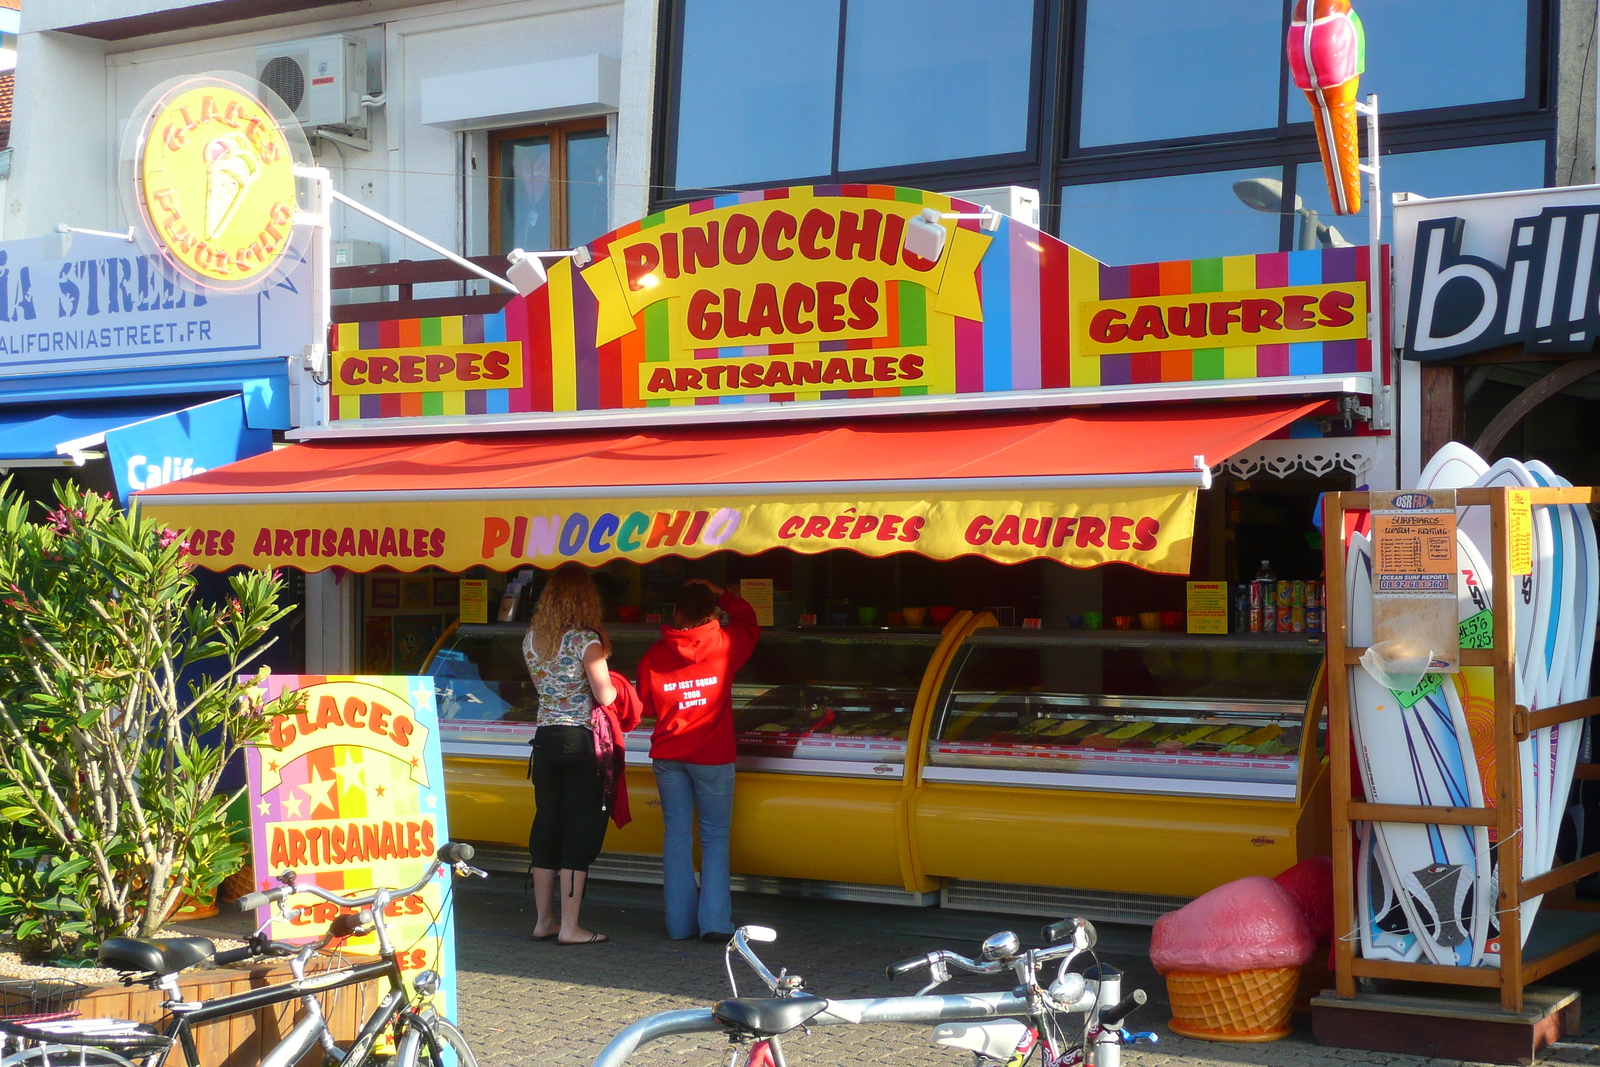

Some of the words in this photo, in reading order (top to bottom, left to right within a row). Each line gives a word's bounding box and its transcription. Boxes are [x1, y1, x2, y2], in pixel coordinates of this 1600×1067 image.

[163, 95, 280, 165] GLACES
[686, 276, 879, 340] GLACES
[1088, 290, 1355, 344] GAUFRES
[339, 350, 511, 386] CREPES
[647, 353, 924, 393] ARTISANALES
[252, 526, 446, 558] ARTISANALES
[481, 507, 741, 559] PINOCCHIO
[777, 507, 926, 543] CRÊPES
[964, 514, 1161, 552] GAUFRES
[1461, 570, 1487, 611] NSP
[695, 676, 718, 688] SQUAD
[269, 695, 415, 750] GLACES
[270, 819, 435, 869] ARTISANALES
